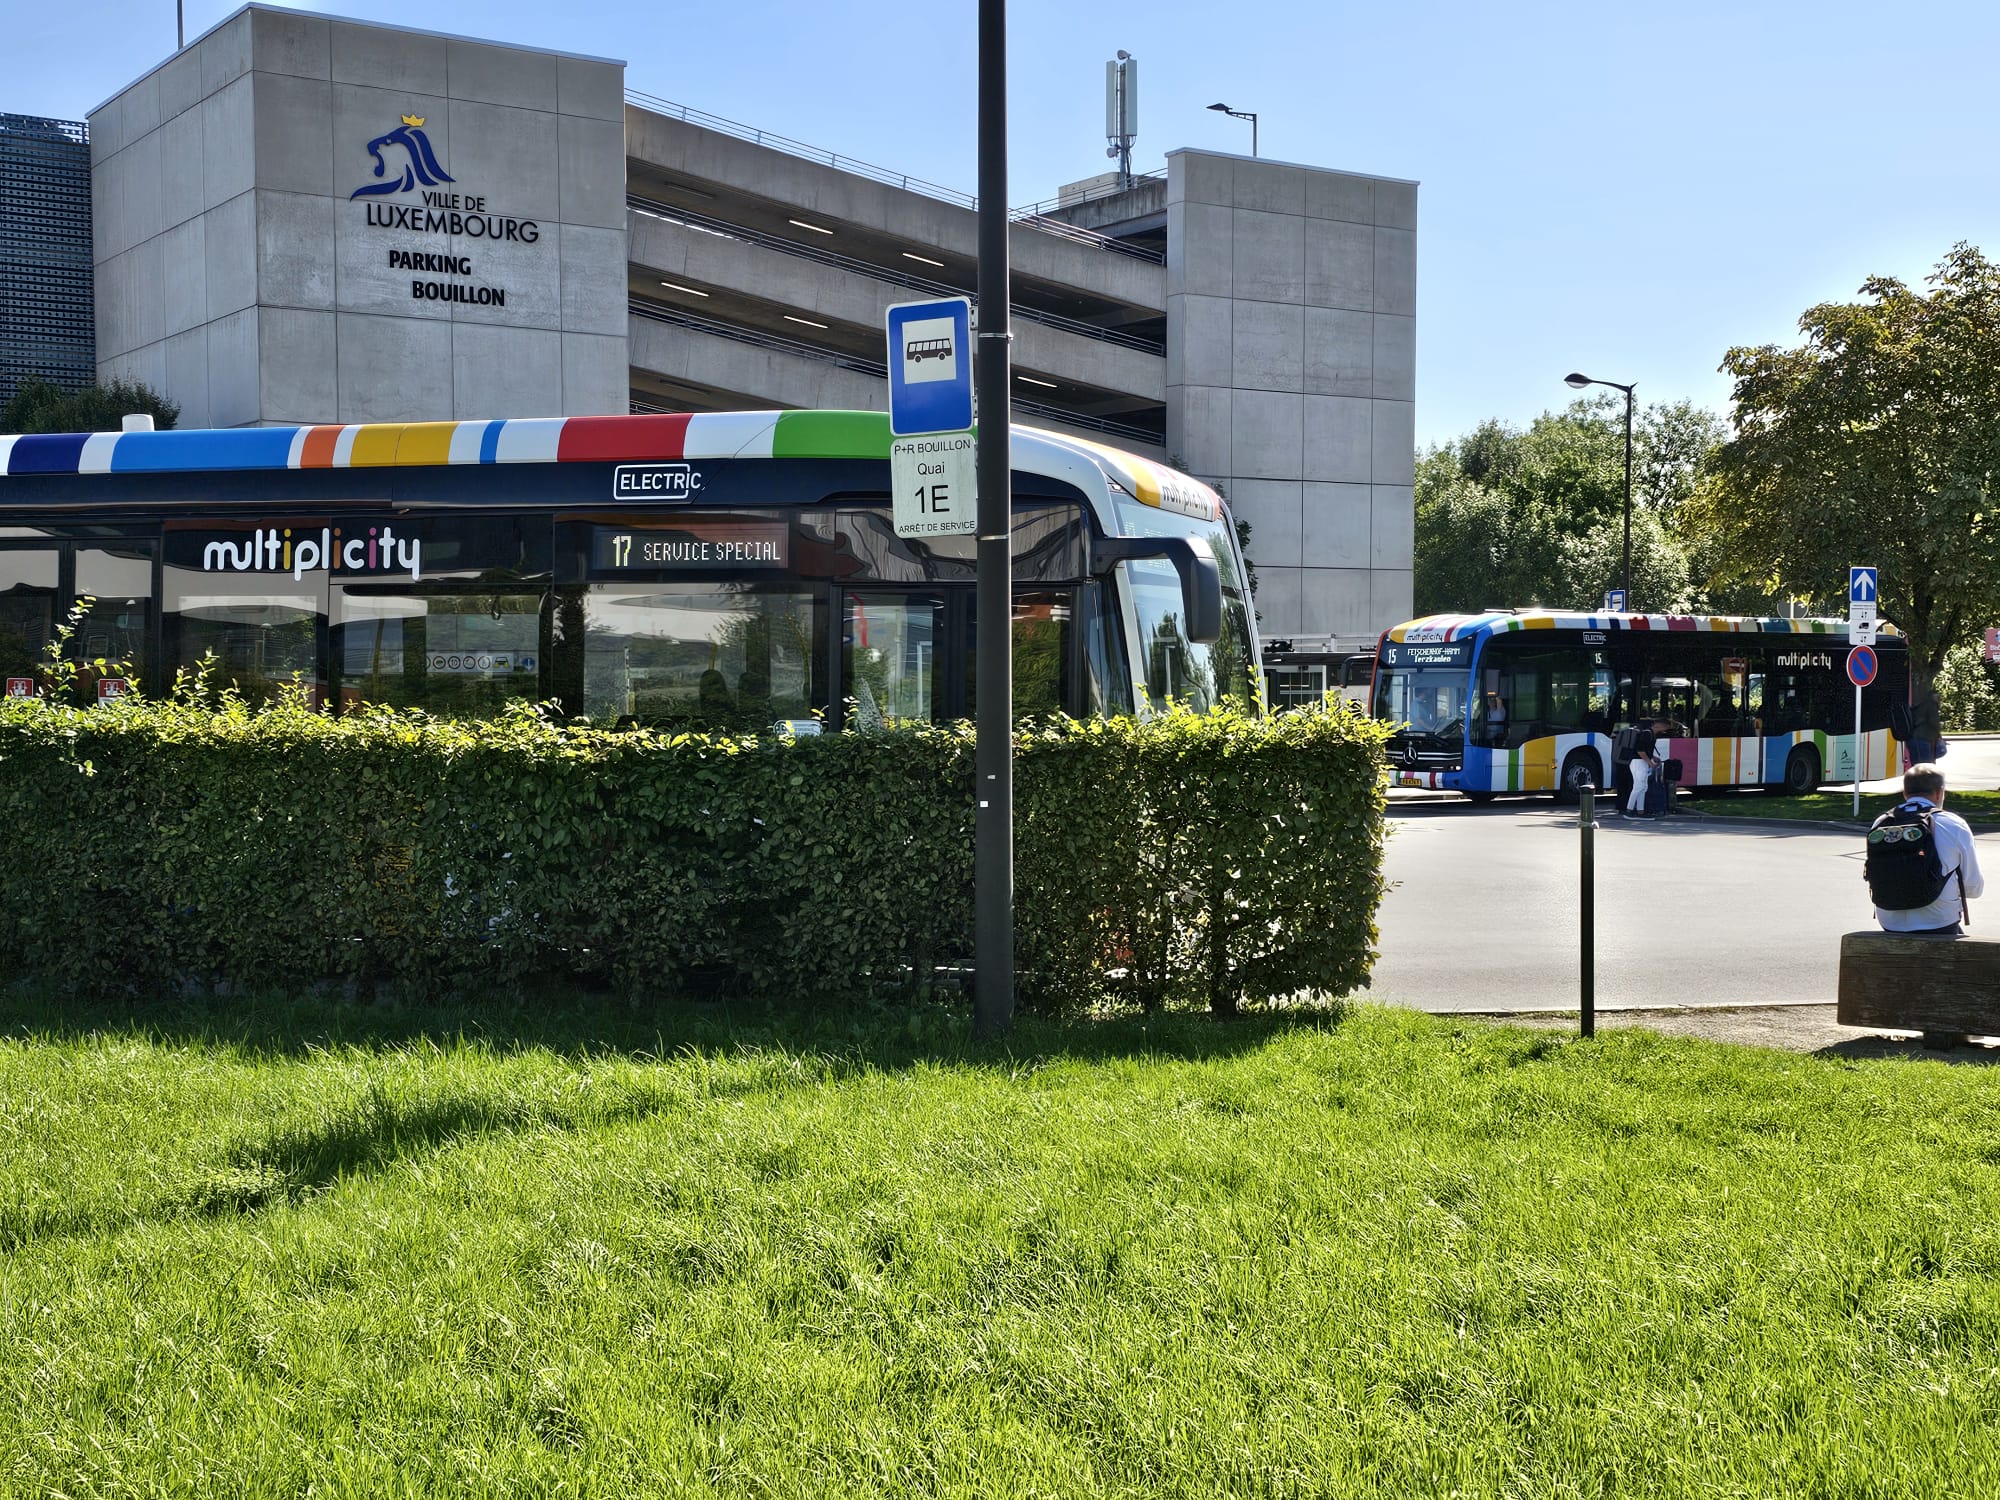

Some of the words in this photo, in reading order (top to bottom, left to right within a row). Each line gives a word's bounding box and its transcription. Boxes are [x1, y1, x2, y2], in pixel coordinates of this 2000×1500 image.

[422, 191, 460, 209] VILLE
[465, 196, 486, 212] DE
[367, 203, 539, 243] LUXEMBOURG
[389, 250, 472, 275] PARKING
[412, 281, 505, 306] BOUILLON
[894, 443, 915, 455] P+R
[917, 440, 971, 453] BOUILLON
[917, 461, 945, 475] Quai
[620, 472, 702, 490] ELECTRIC
[915, 484, 950, 514] 1E
[899, 523, 925, 533] ARRÊT
[927, 523, 938, 532] DE
[940, 521, 976, 531] SERVICE
[203, 526, 421, 582] multiplicity
[612, 535, 632, 567] 17
[643, 542, 710, 561] SERVICE
[715, 542, 781, 561] SPECIAL
[1388, 649, 1397, 664] 15
[1595, 652, 1603, 664] 15
[1777, 652, 1831, 670] multiplicity
